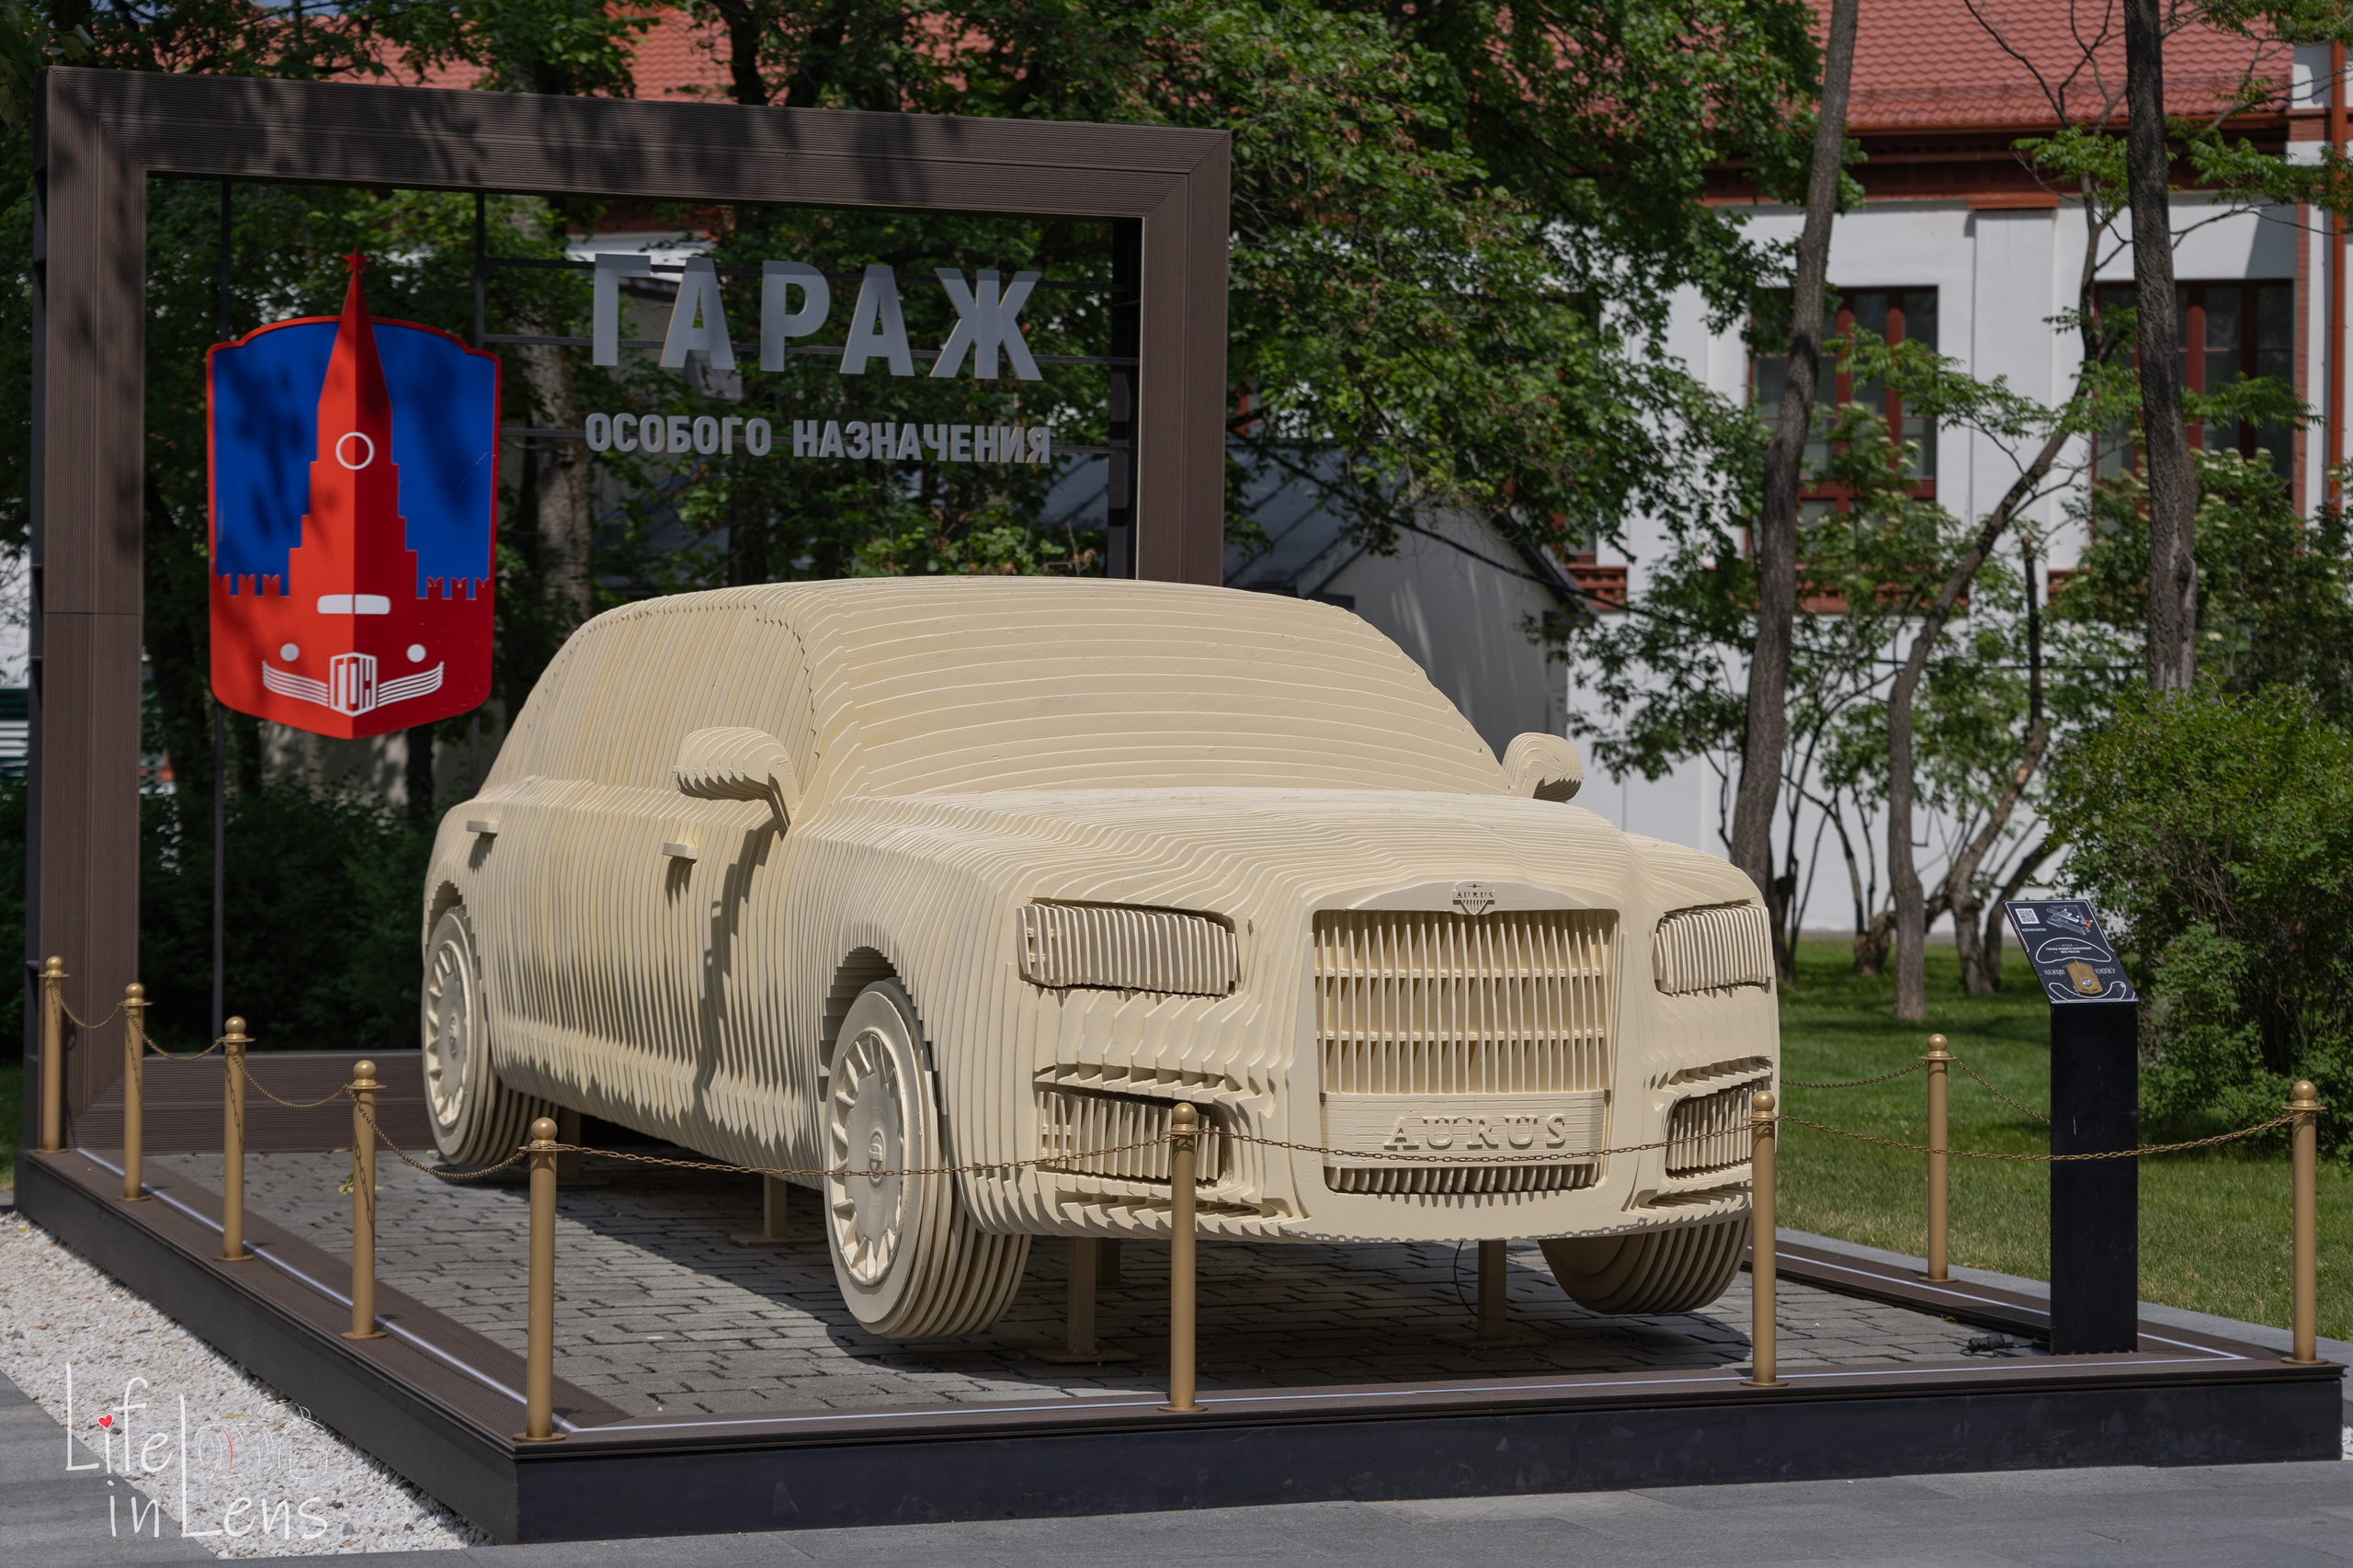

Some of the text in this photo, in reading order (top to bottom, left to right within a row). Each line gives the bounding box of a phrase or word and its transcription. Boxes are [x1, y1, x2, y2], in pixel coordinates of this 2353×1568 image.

[593, 254, 1043, 381] ГАРАЖ
[585, 412, 1051, 464] ОСОБОГО НАЗНАЧЕНИЯ
[1383, 1114, 1566, 1150] AURUS
